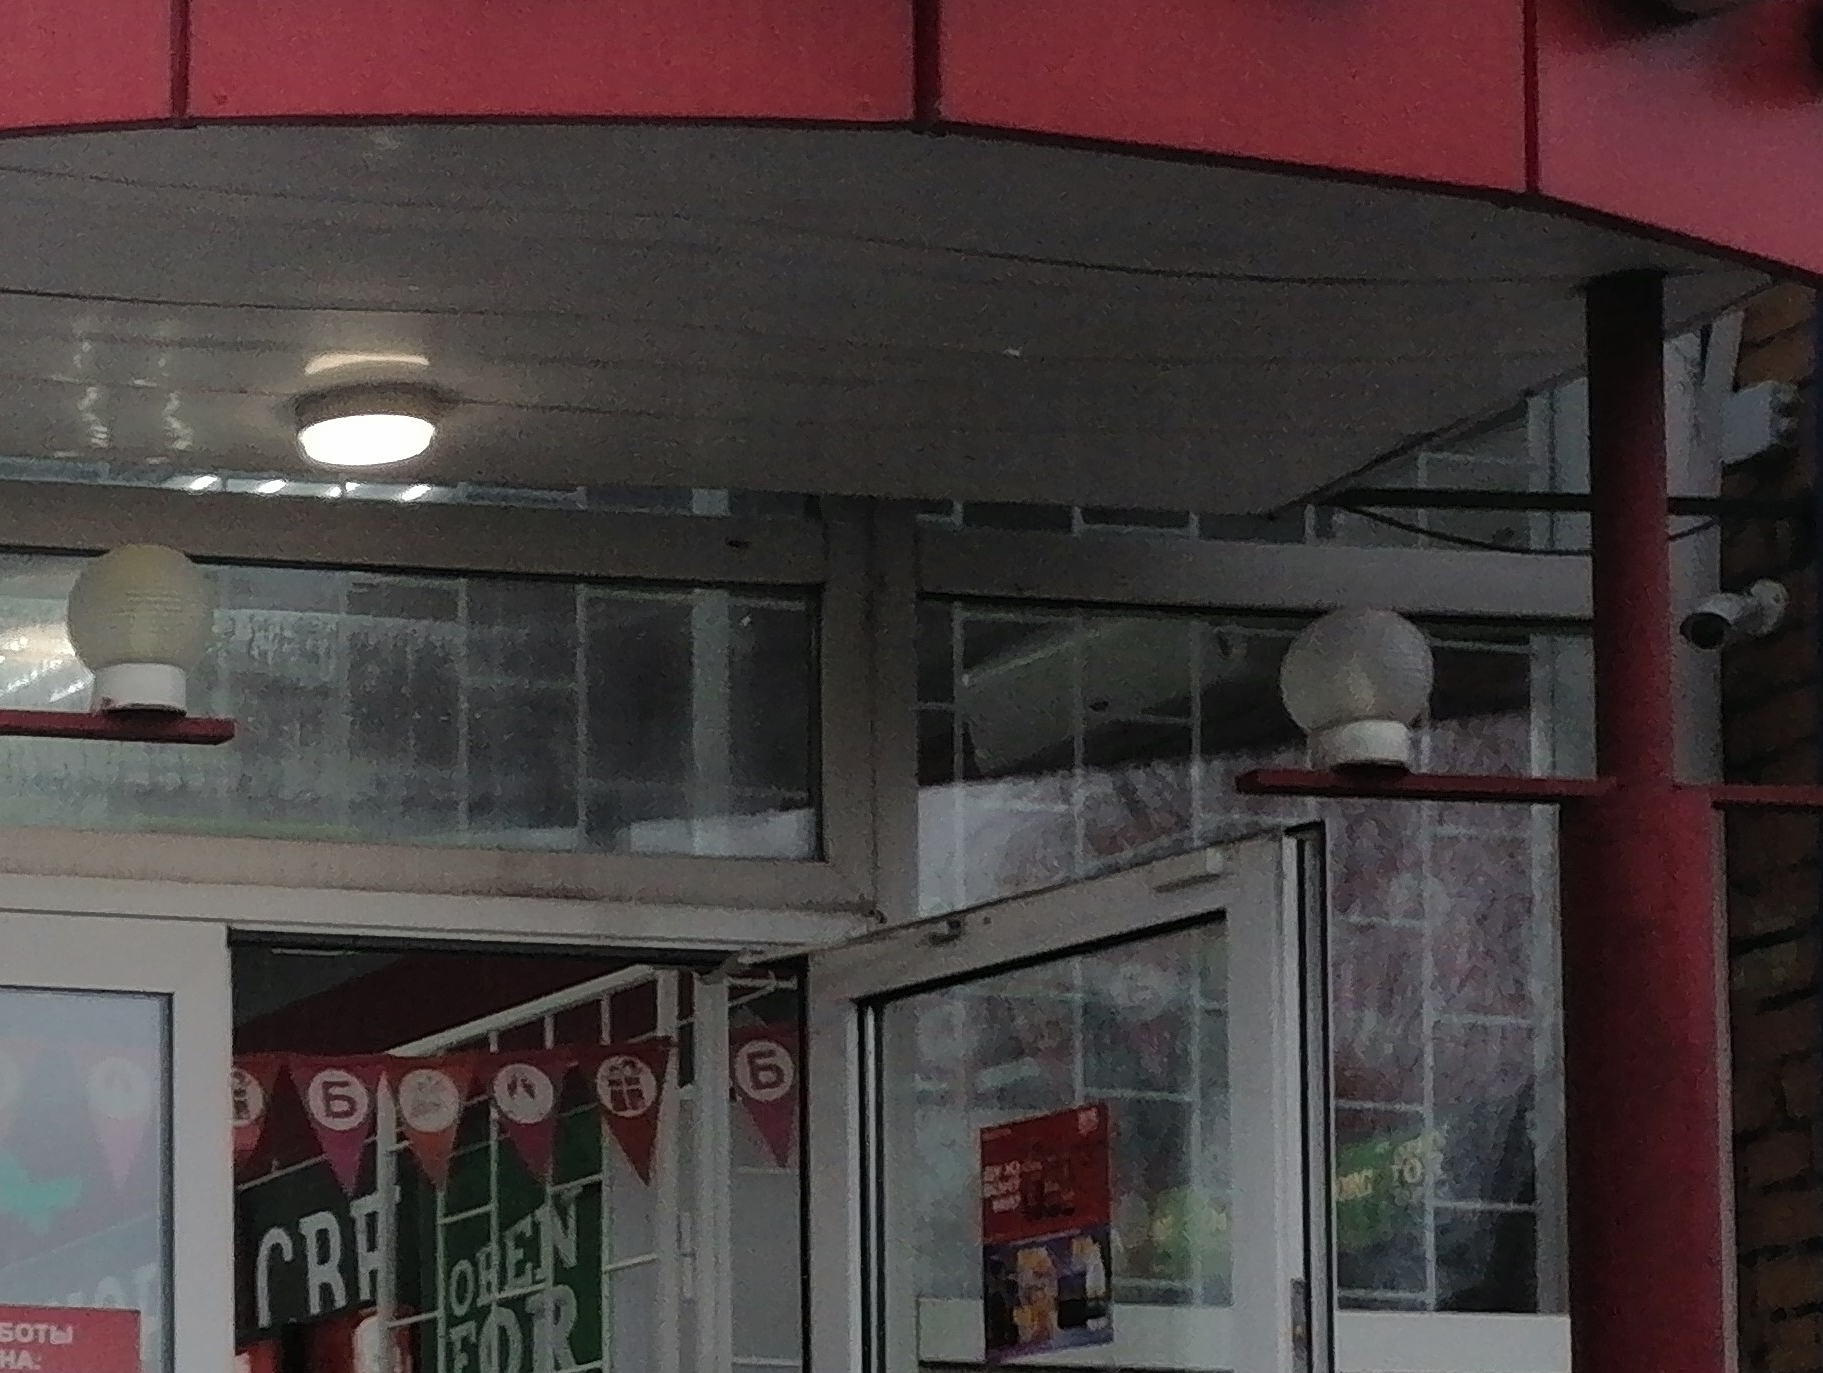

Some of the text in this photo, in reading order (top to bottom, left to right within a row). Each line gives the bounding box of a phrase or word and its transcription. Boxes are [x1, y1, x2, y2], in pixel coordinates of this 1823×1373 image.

[746, 1049, 785, 1090] Б
[321, 1080, 357, 1119] Б
[448, 1184, 584, 1318] OPEN
